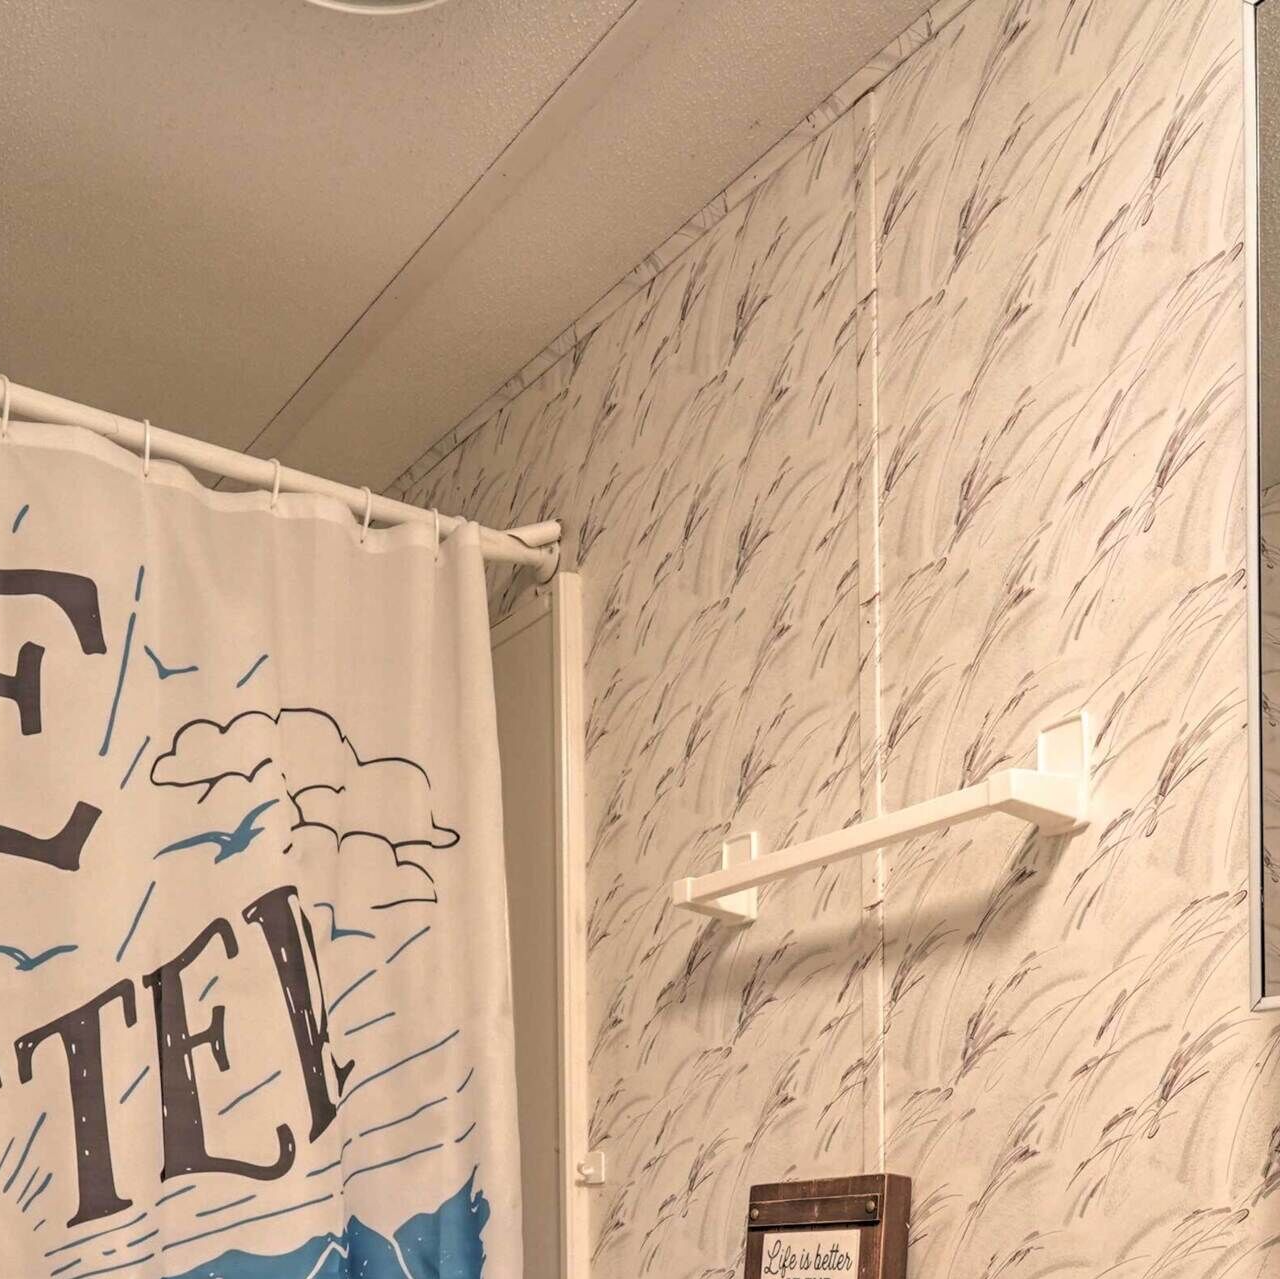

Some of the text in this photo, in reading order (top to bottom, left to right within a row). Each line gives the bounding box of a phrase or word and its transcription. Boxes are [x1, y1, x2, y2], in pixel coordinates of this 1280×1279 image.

[764, 1240, 853, 1278] Life is better
